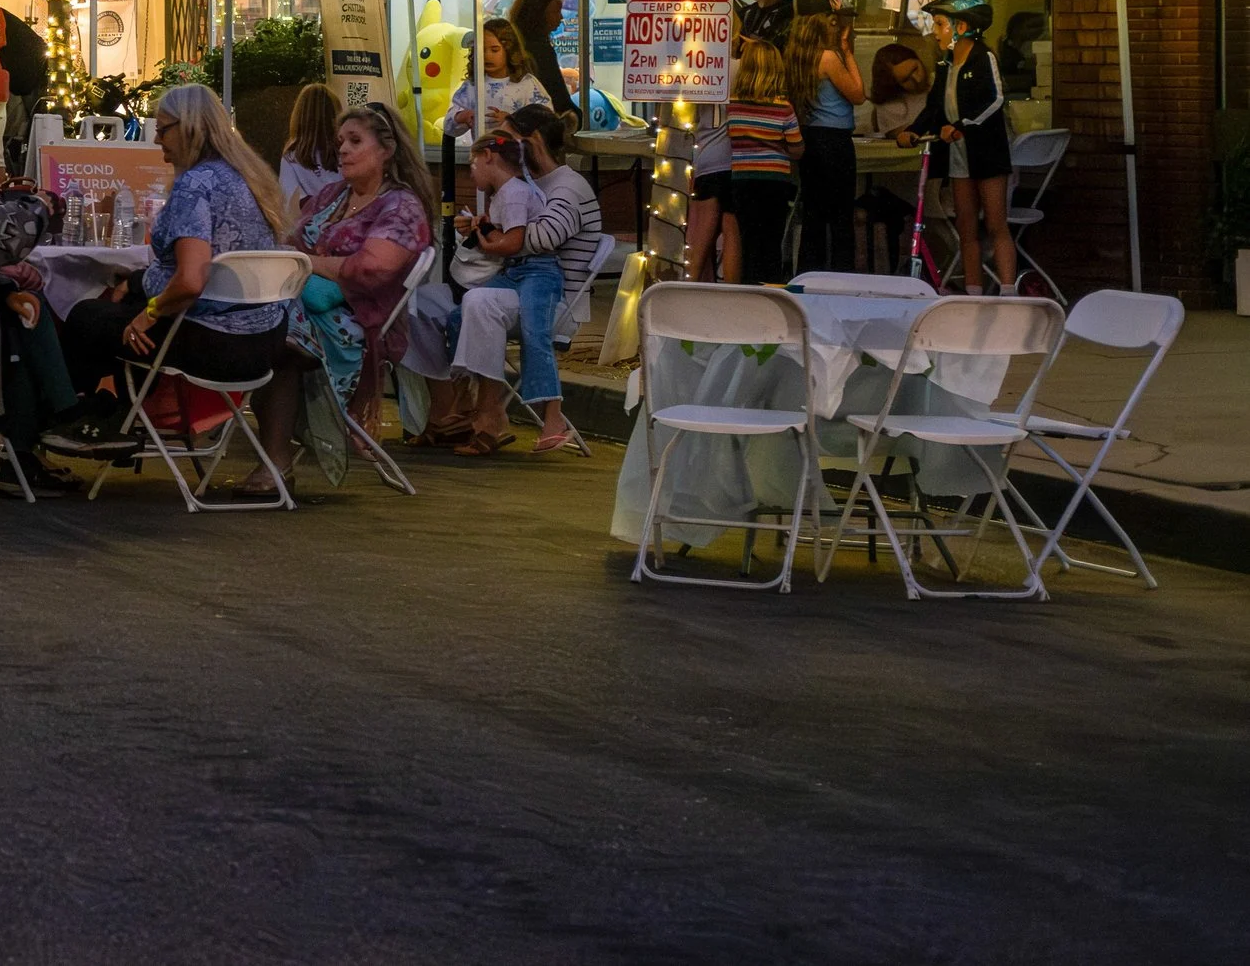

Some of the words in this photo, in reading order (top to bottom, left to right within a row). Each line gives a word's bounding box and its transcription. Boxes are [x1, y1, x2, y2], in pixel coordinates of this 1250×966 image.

[642, 3, 715, 12] TEMPORARY
[630, 17, 649, 41] NO
[655, 17, 728, 43] STOPPING
[630, 49, 657, 67] 2PM
[667, 56, 678, 65] TO
[686, 50, 723, 69] 10PM
[627, 74, 688, 85] SATURDAY
[692, 75, 724, 86] ONLY
[58, 163, 114, 175] SECOND
[59, 178, 126, 191] SATURDAY
